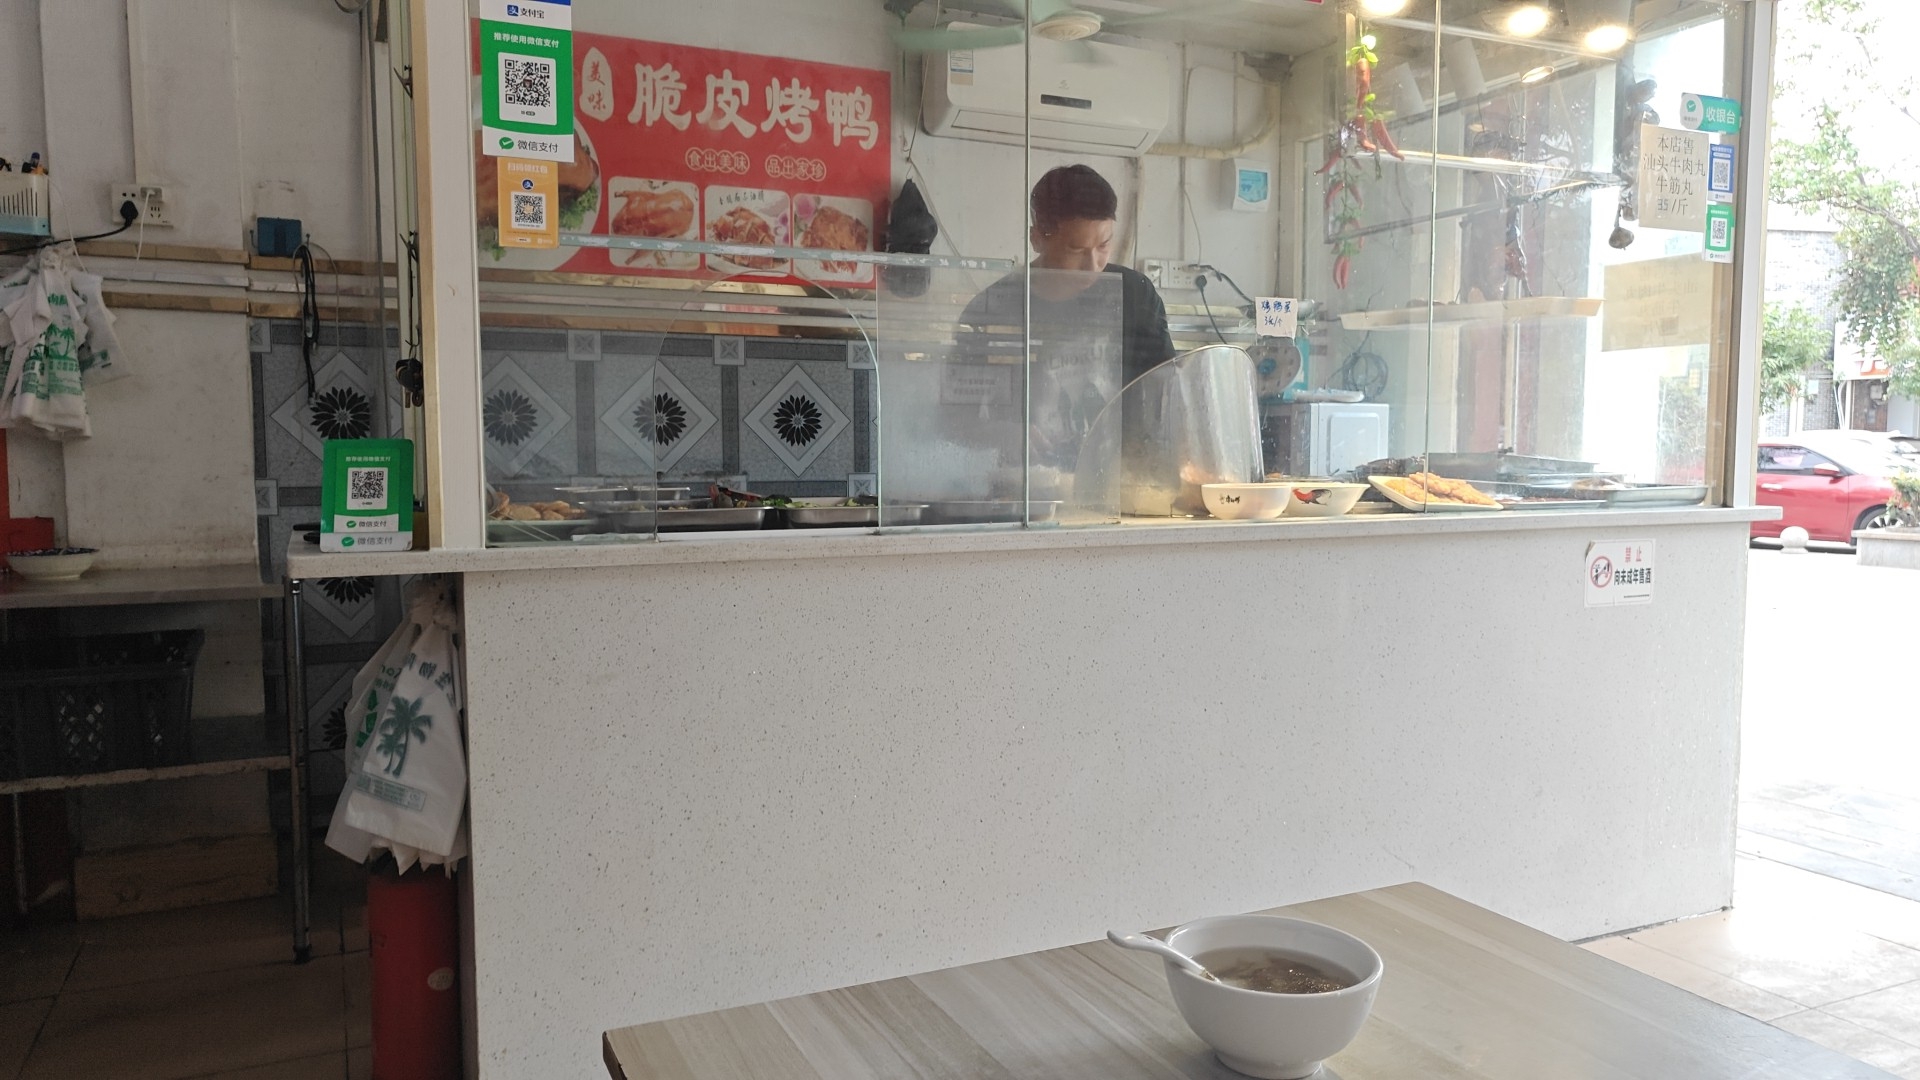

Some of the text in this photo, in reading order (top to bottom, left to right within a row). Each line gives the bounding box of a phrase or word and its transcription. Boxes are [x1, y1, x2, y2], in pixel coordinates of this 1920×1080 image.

[520, 8, 545, 19] 支付宝
[493, 32, 559, 48] 推荐使用微信支付
[587, 61, 606, 111] 美味
[627, 62, 879, 151] 脆皮烤鸭
[1705, 106, 1736, 125] 收银台
[517, 139, 559, 153] 微信支付
[1657, 134, 1694, 155] 本店售
[687, 150, 748, 173] 食出美味
[767, 156, 825, 180] 品出家珍
[1643, 153, 1706, 177] 汕头牛肉丸
[1656, 175, 1693, 195] 牛筋丸
[357, 536, 393, 545] 微信支付
[1625, 546, 1642, 563] 禁止
